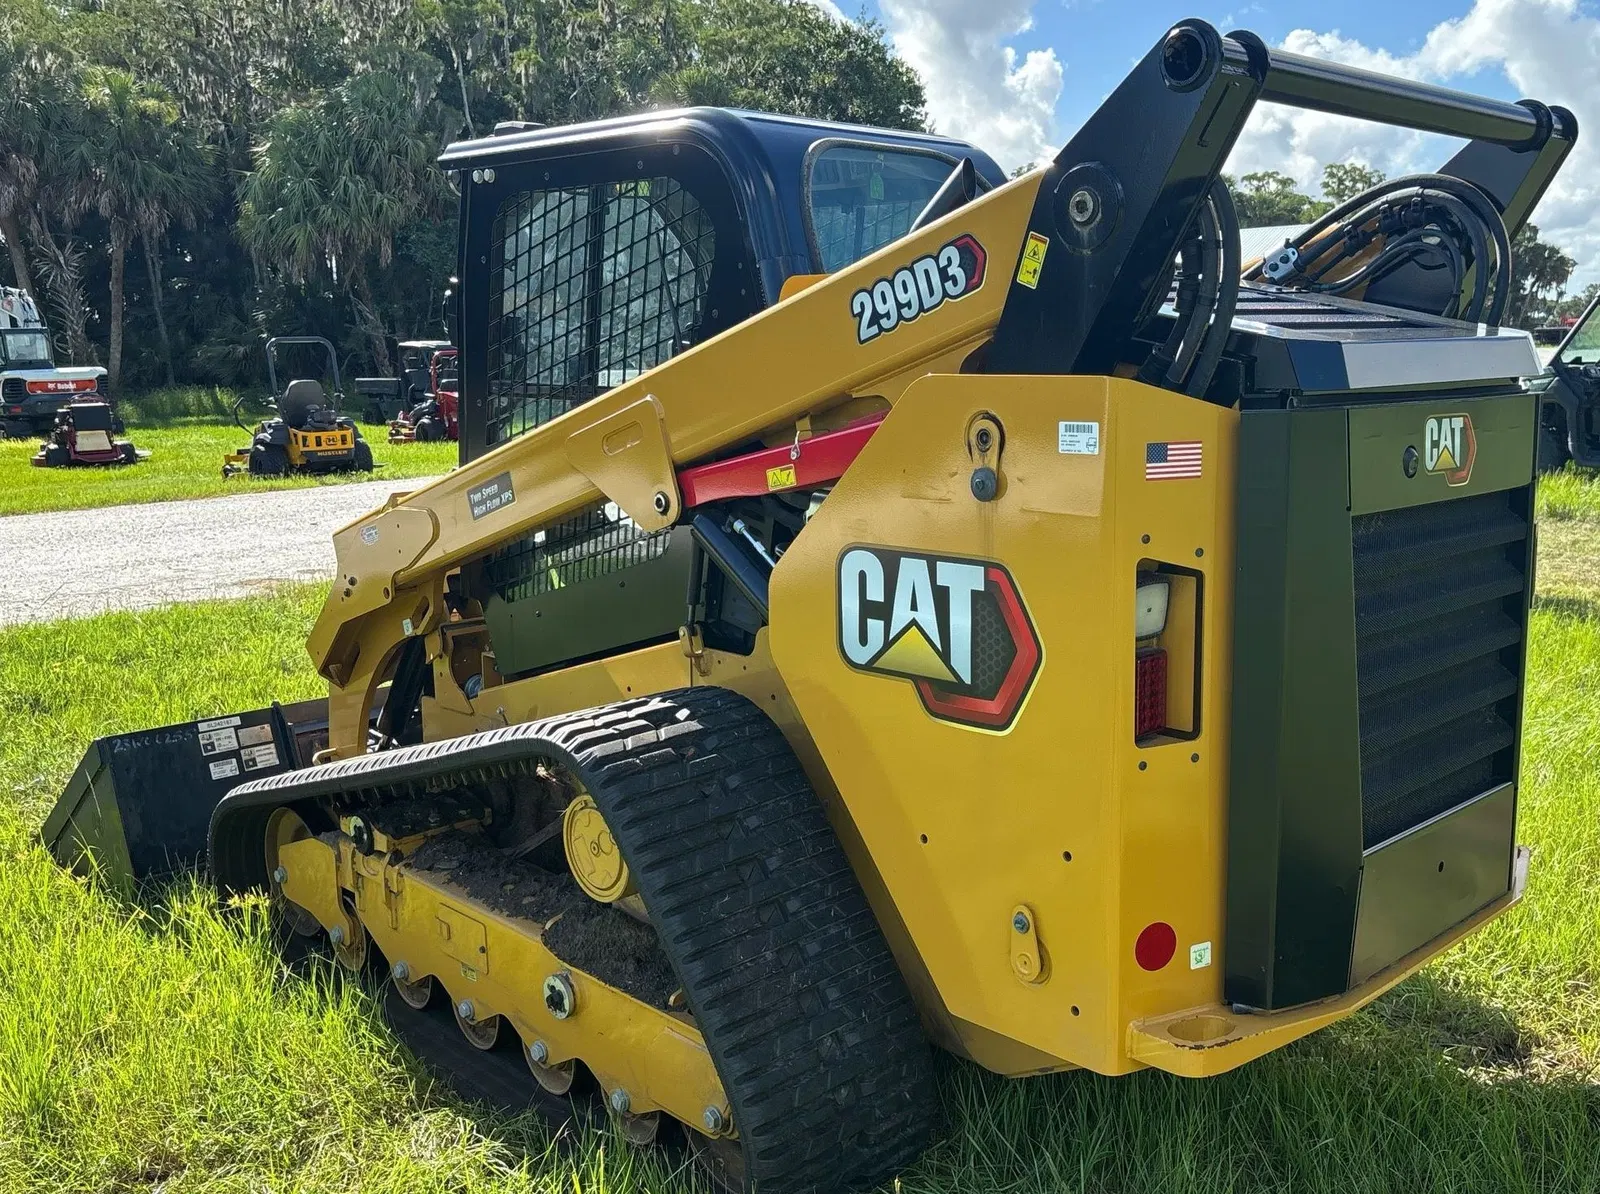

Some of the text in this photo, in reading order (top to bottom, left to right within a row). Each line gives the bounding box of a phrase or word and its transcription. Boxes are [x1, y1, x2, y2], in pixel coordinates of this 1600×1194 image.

[853, 245, 966, 341] 299D3
[1425, 416, 1464, 471] CAT
[500, 489, 513, 504] XPS
[841, 549, 985, 685] CAT
